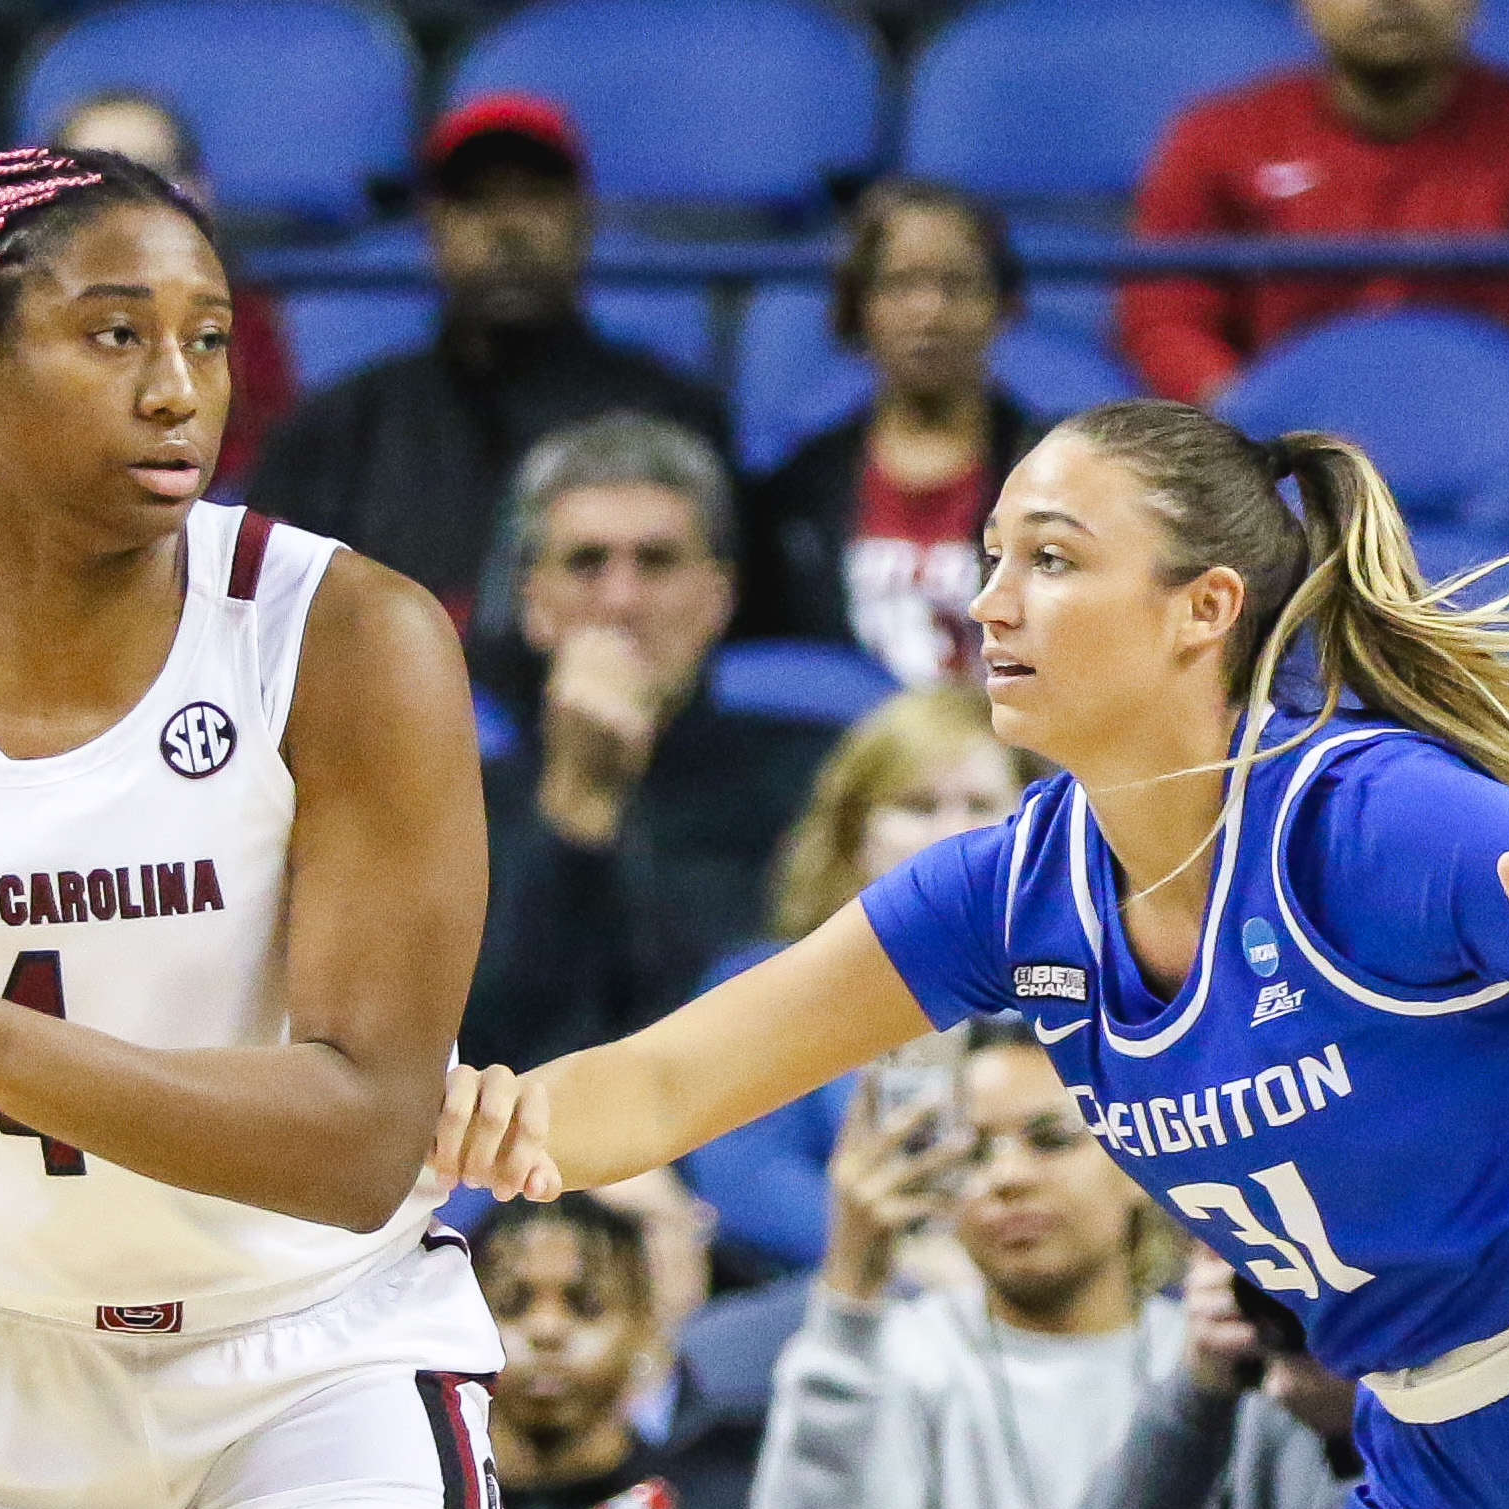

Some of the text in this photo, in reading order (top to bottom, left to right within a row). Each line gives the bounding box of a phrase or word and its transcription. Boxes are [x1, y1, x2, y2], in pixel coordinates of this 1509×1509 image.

[164, 704, 232, 774] SEC
[1252, 988, 1306, 1019] EAST
[1166, 1160, 1377, 1300] 31
